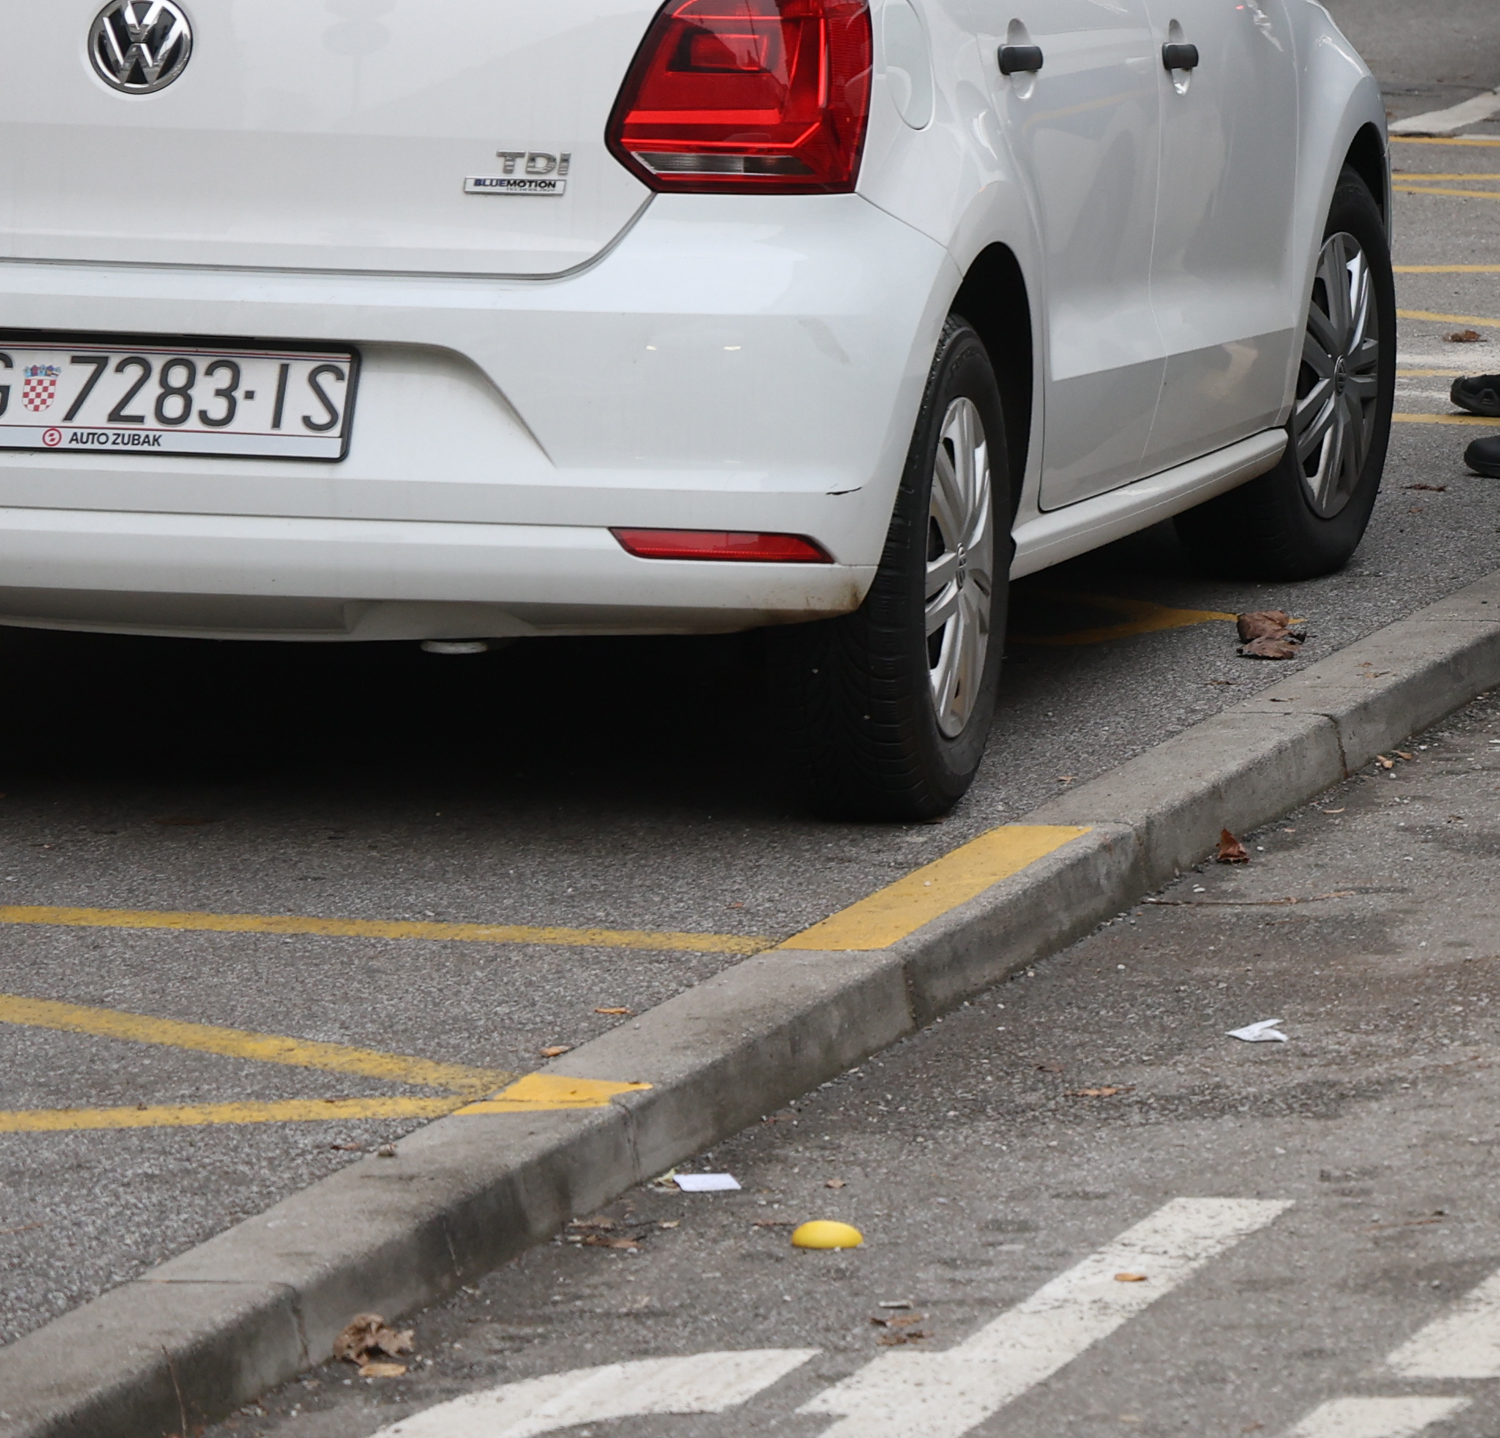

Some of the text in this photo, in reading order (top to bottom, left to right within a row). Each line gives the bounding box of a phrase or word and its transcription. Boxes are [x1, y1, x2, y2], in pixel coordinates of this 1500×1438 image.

[496, 149, 571, 175] TDI
[474, 178, 556, 189] BLUEMOTION
[68, 431, 163, 447] AUTO ZUBAK
